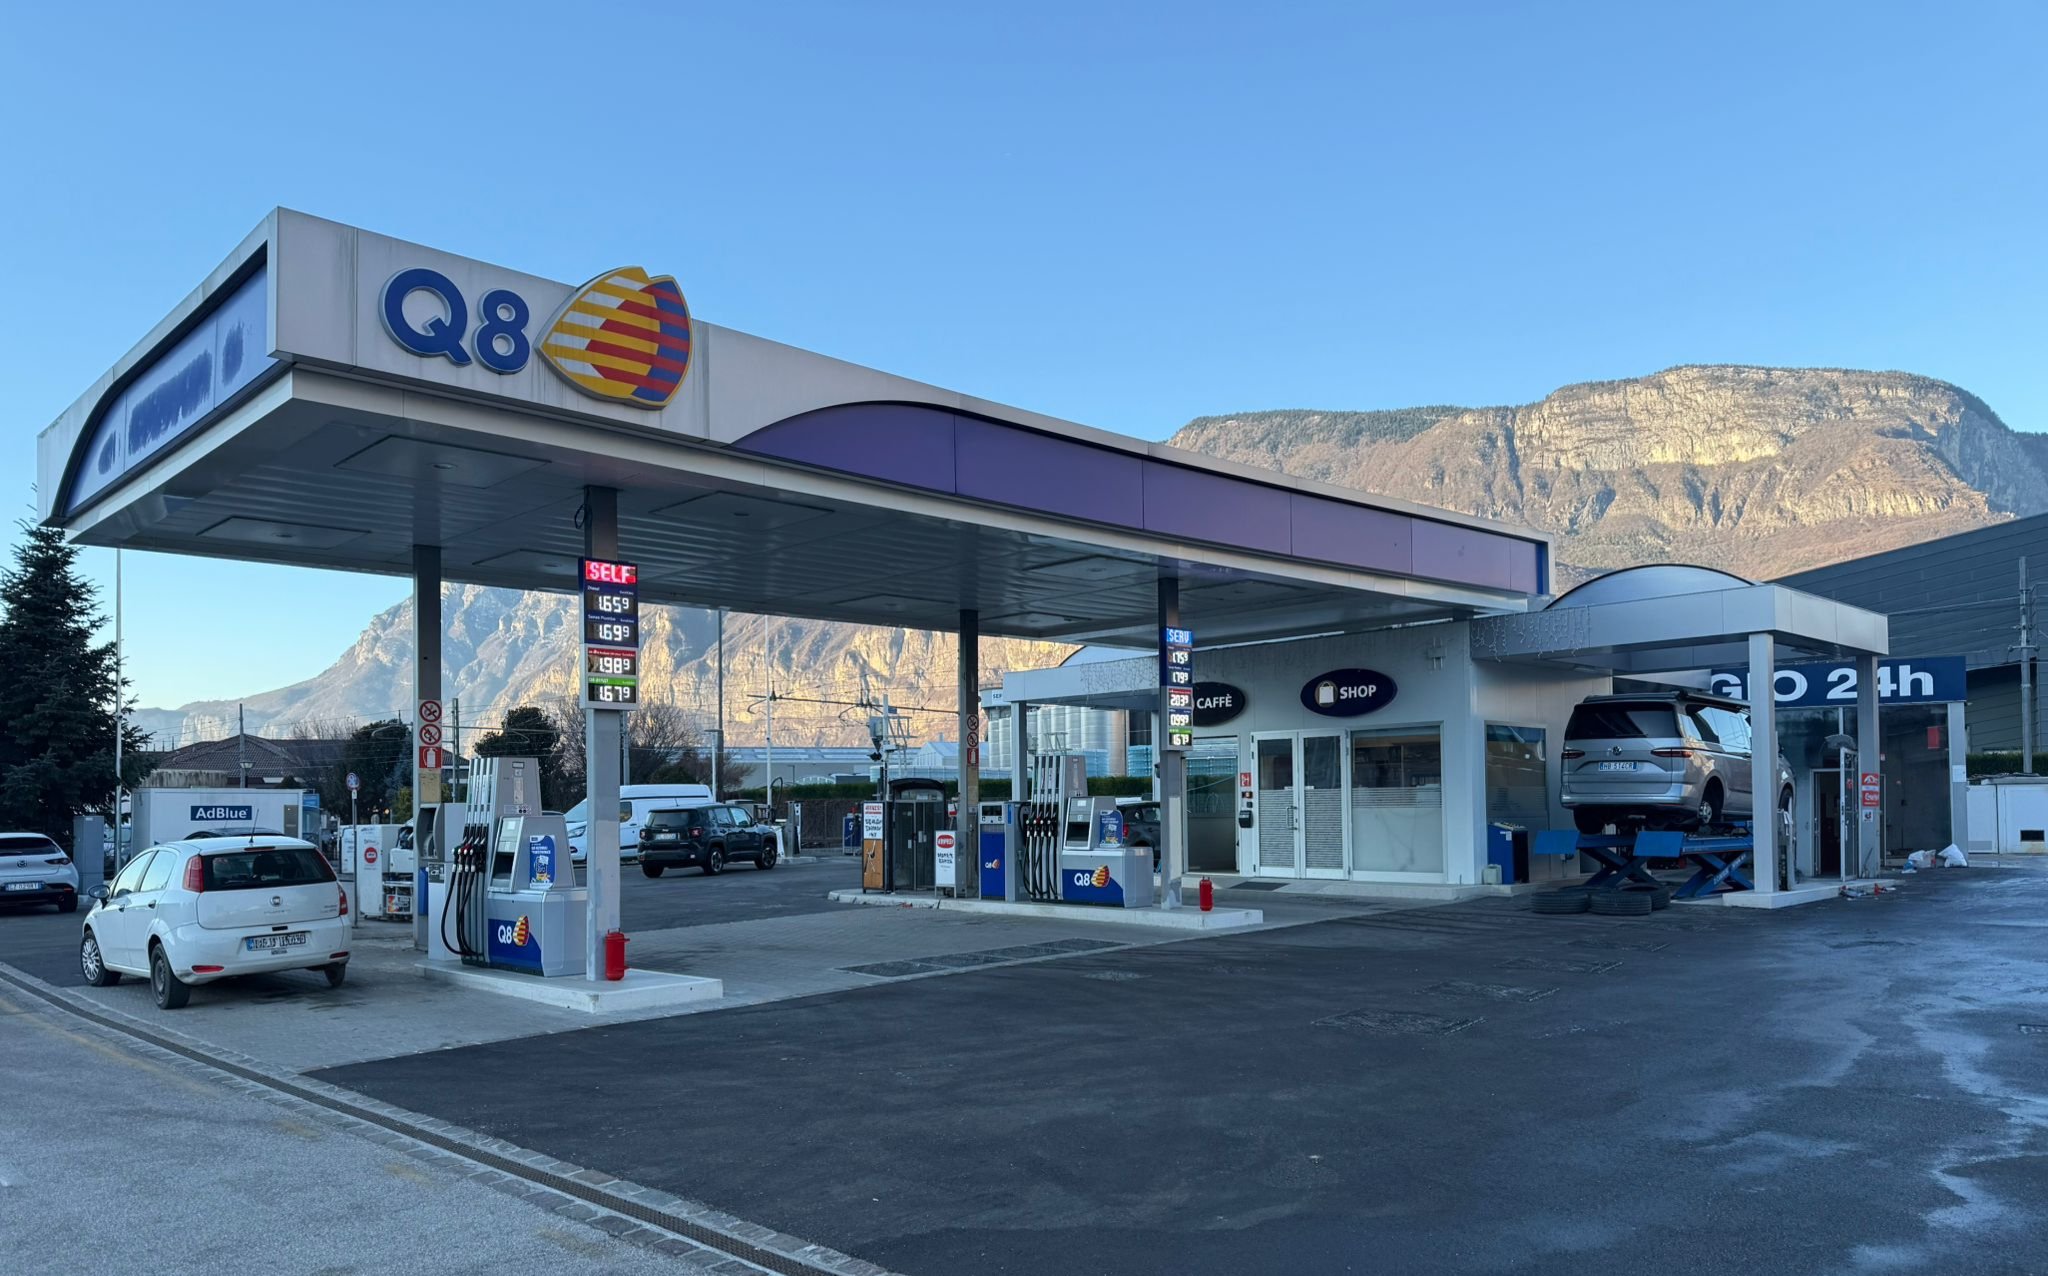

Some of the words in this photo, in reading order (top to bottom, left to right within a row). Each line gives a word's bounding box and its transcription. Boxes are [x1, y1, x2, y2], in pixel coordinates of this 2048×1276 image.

[378, 267, 531, 375] Q8
[589, 561, 637, 584] SELF
[1339, 684, 1377, 700] SHOP
[1196, 693, 1233, 709] CAFFÈ
[195, 807, 248, 819] AdBlue
[1073, 872, 1091, 887] Q8
[497, 924, 513, 945] Q8
